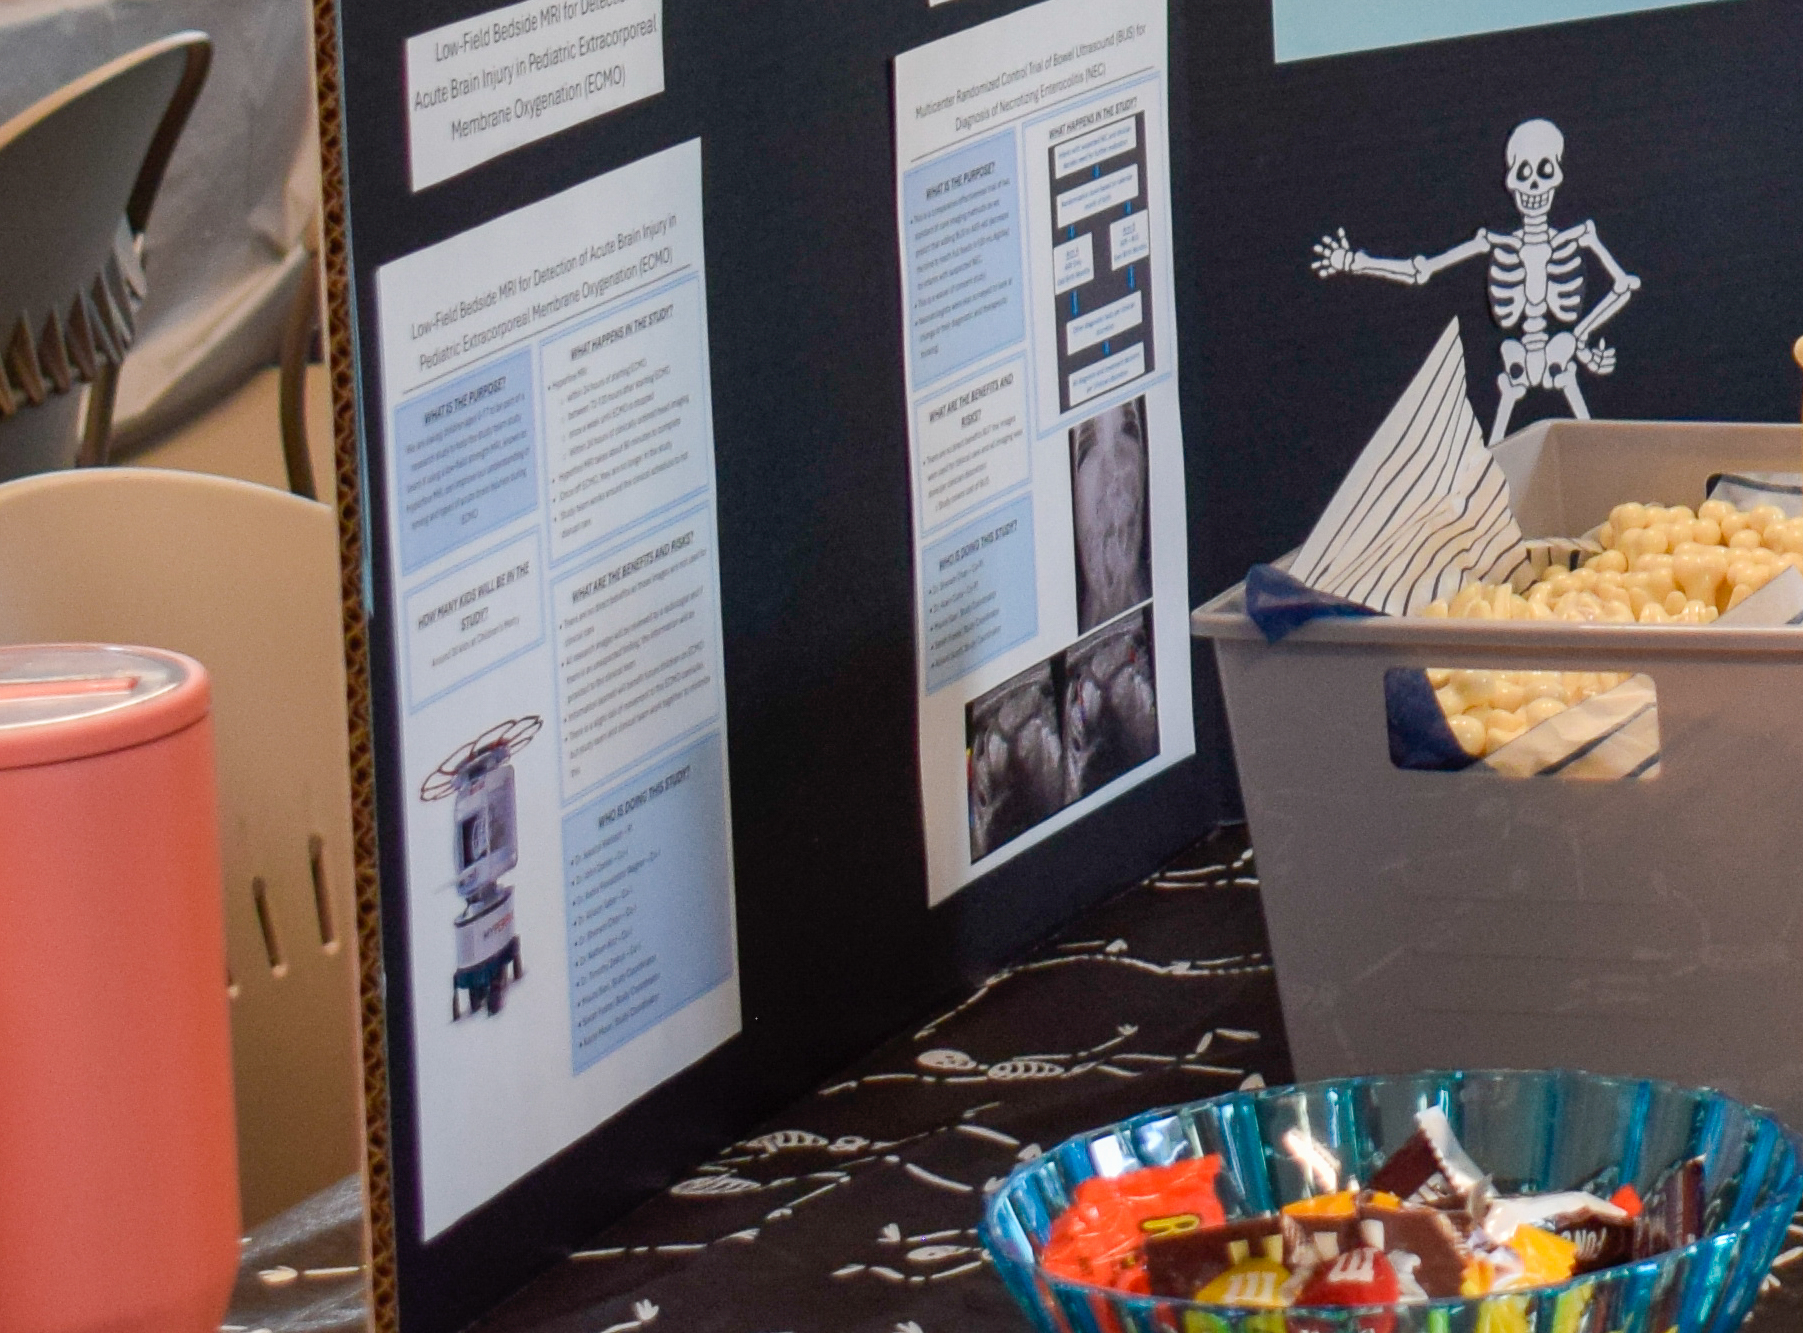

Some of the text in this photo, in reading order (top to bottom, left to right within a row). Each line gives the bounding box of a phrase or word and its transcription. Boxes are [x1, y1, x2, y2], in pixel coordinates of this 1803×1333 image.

[414, 14, 656, 111] Acute Brain Injury in Pediatric Extracorporeal
[436, 26, 490, 62] Low-Field
[494, 13, 537, 43] Bedside
[540, 3, 561, 28] MRI
[564, 1, 578, 21] for
[916, 22, 1146, 119] Multicenter Randomized Control Trial of Bowel Ultrasound (BUS) for
[452, 63, 625, 140] Membrane Oxygenation (ECMO)
[955, 64, 1106, 132] Diagnosis of Necrotizing Enterocolitis (NEC)
[411, 212, 676, 340] Low-Field Bedside MRI for Detection of Acute Brain Injury in
[419, 245, 673, 371] Pediatric Extracorporeal Membrane Oxygenation (ECMO)
